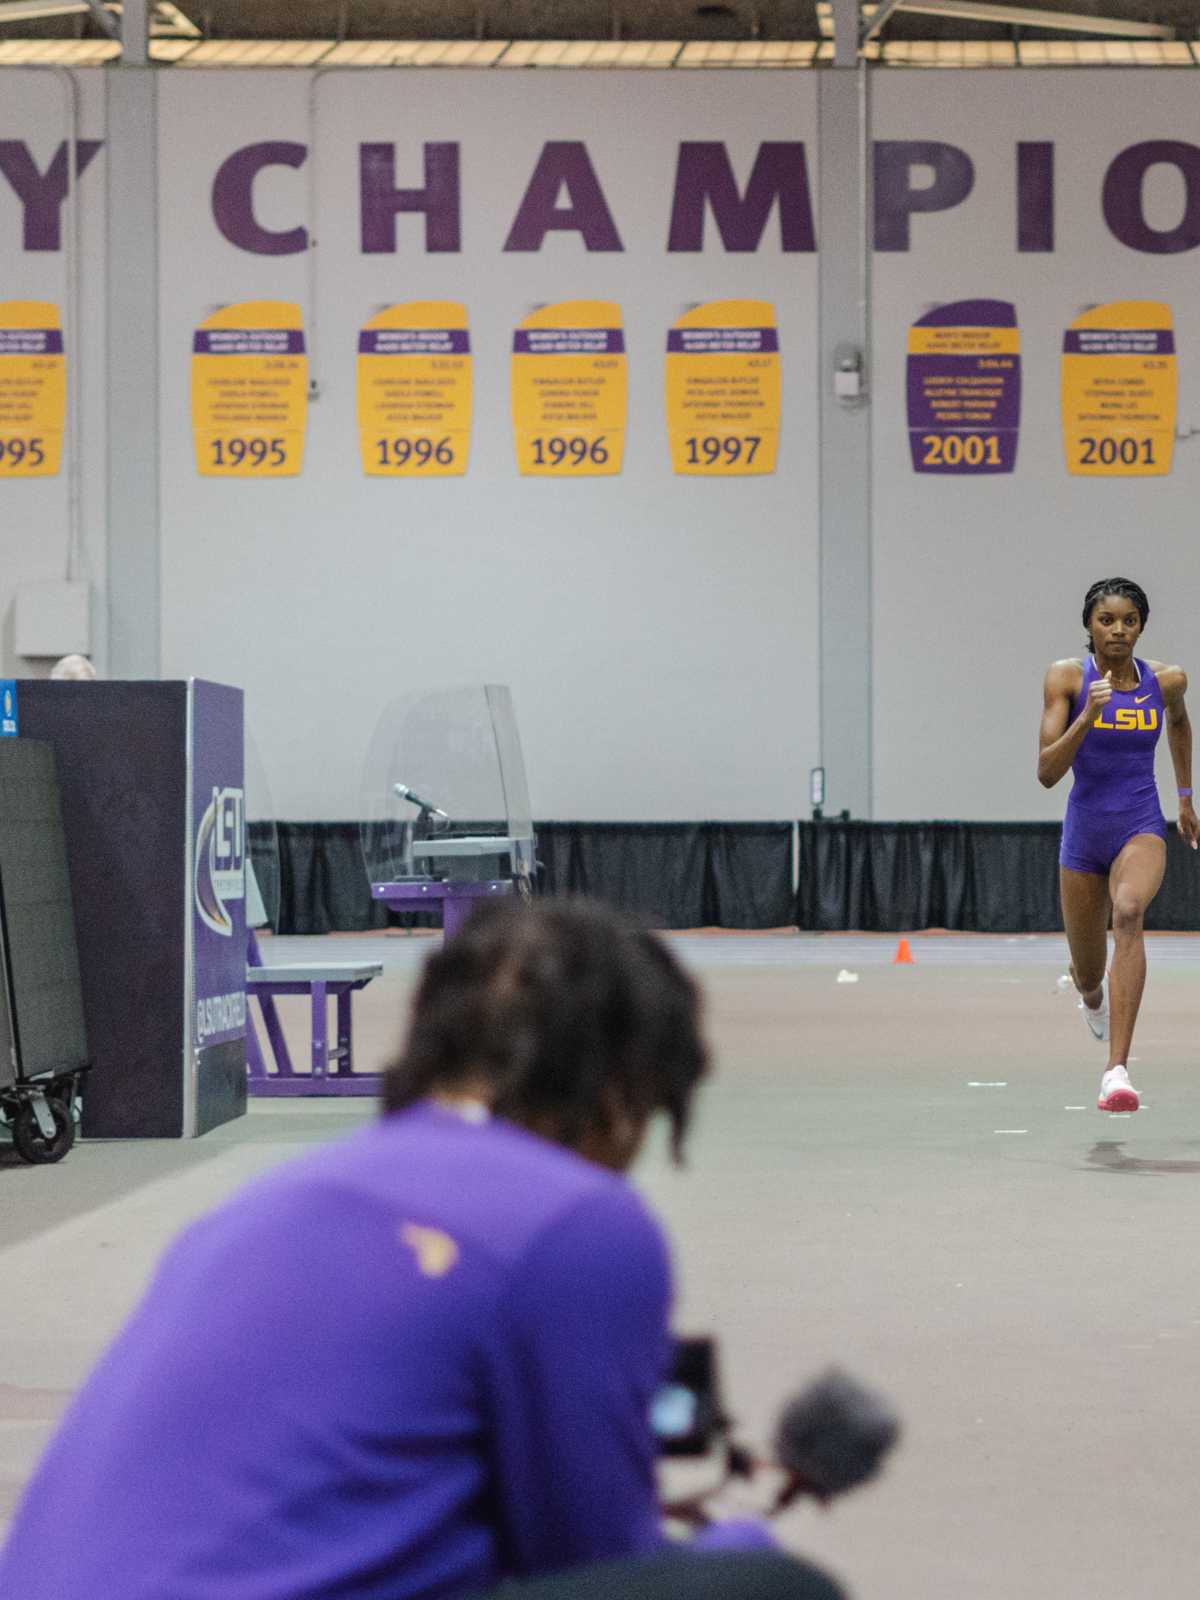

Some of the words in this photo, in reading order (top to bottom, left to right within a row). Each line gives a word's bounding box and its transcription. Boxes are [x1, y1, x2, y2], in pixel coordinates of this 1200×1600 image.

[211, 438, 287, 467] 1995
[376, 437, 454, 466] 1996
[530, 436, 609, 466] 1996
[685, 436, 762, 465] 1997
[922, 435, 1002, 466] 2001
[1079, 437, 1156, 466] 2001
[1093, 708, 1158, 731] LSU
